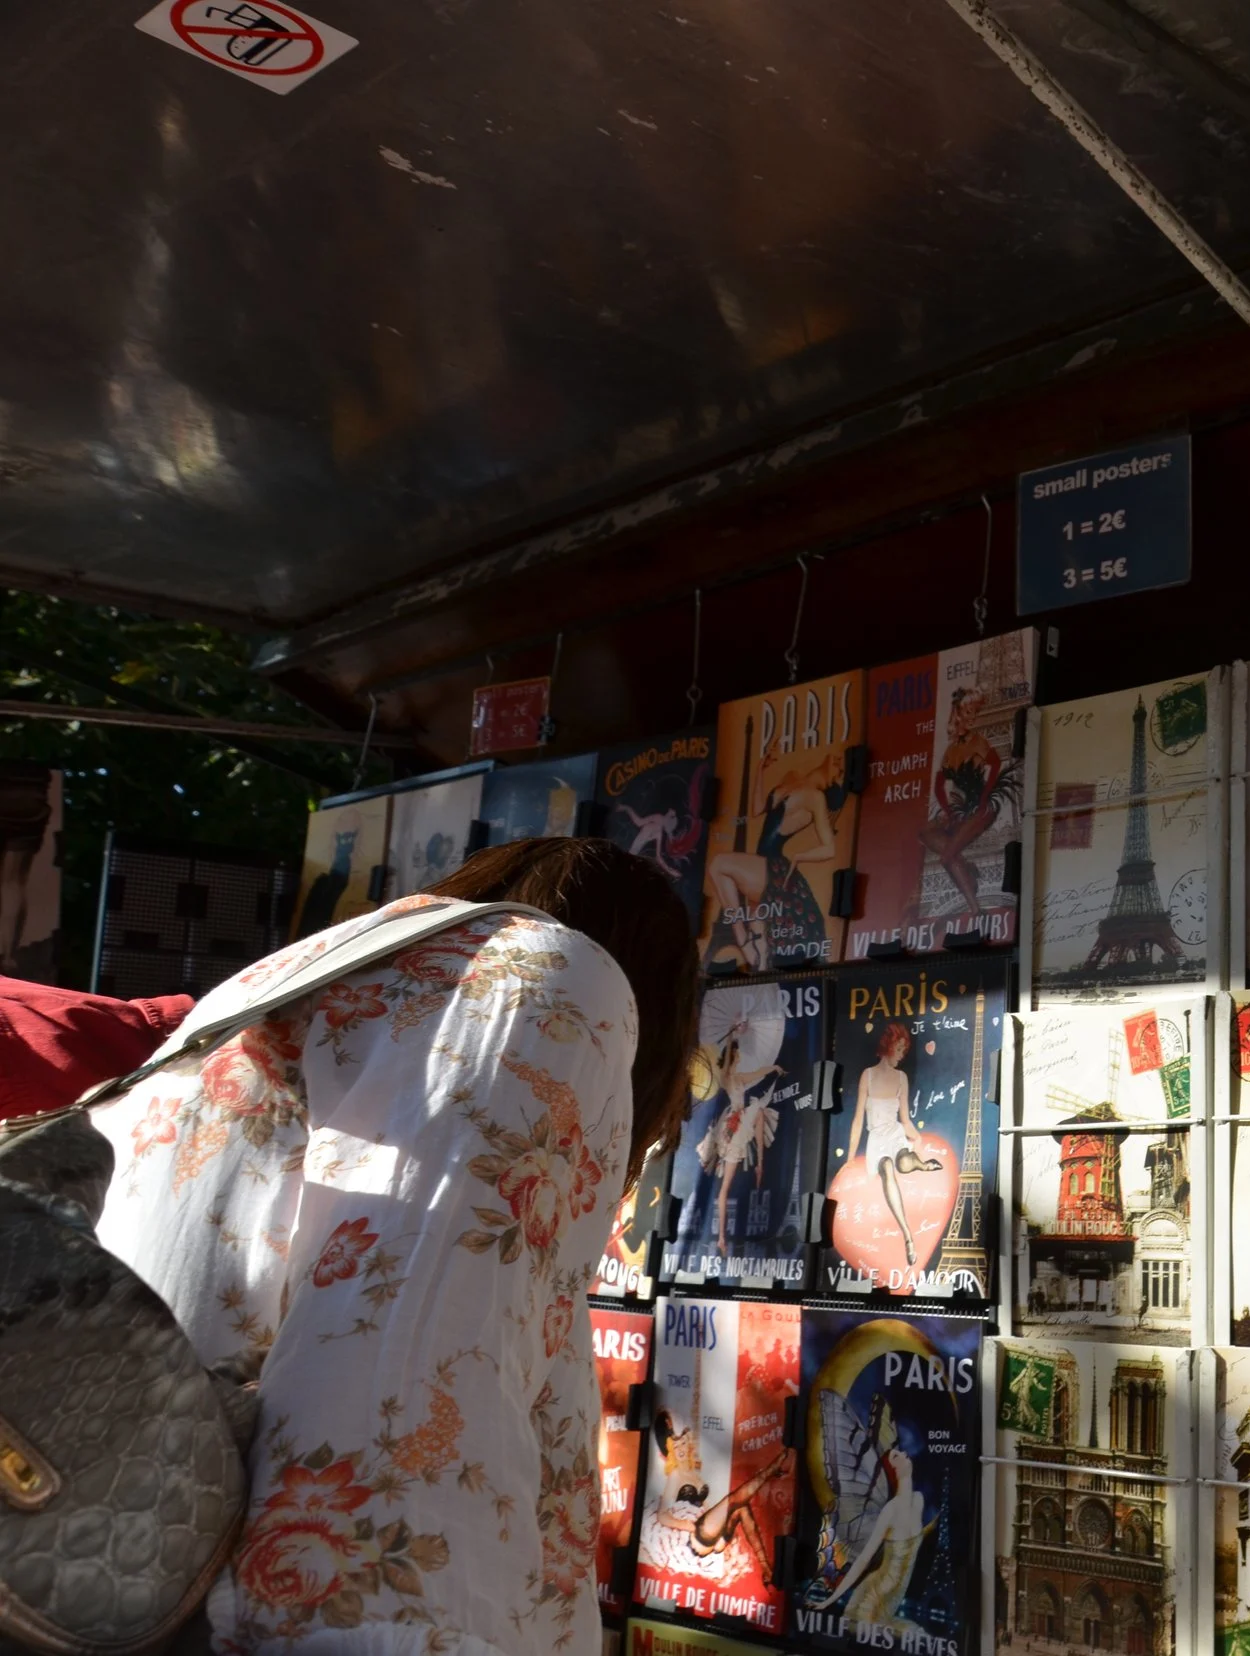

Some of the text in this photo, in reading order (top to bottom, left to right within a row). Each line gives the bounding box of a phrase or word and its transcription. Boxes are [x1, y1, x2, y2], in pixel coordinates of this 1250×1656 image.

[1033, 452, 1172, 499] small posters
[1063, 509, 1126, 540] 1 = 2€
[1063, 557, 1127, 588] 3 = 5€
[946, 660, 977, 680] EIFFEL
[876, 670, 934, 720] PARIS
[513, 703, 530, 717] 2€
[759, 682, 852, 759] PARIS
[511, 724, 527, 738] 5€
[915, 719, 936, 736] THE
[604, 748, 658, 797] CASINO
[670, 736, 710, 760] PARIS
[868, 751, 928, 778] TRIUMPH
[884, 779, 921, 803] ARCH
[722, 902, 784, 925] SALON
[771, 927, 788, 939] de
[853, 928, 902, 958] VILLE
[906, 922, 935, 951] DES
[776, 939, 833, 959] MODE
[742, 985, 821, 1019] PARIS
[1086, 1221, 1127, 1236] ROUGE
[700, 1255, 723, 1277] DES
[725, 1256, 805, 1281] NOCTAMBULES
[889, 1268, 974, 1293] D'AMOUR
[664, 1304, 719, 1352] PARIS
[592, 1328, 648, 1363] ARIS
[668, 1373, 691, 1390] TOWER
[884, 1352, 974, 1395] PARIS
[702, 1415, 726, 1432] EIFFEL
[737, 1412, 778, 1435] FRENCH
[927, 1430, 950, 1440] BON
[741, 1426, 784, 1453] CANCAN
[928, 1443, 968, 1455] VOYAGE
[639, 1576, 682, 1608] VILLE
[685, 1586, 706, 1612] DE
[709, 1588, 778, 1630] LUMIÈRE
[632, 1626, 683, 1656] MOULIN
[796, 1609, 850, 1640] VILLE
[855, 1620, 896, 1650] DES
